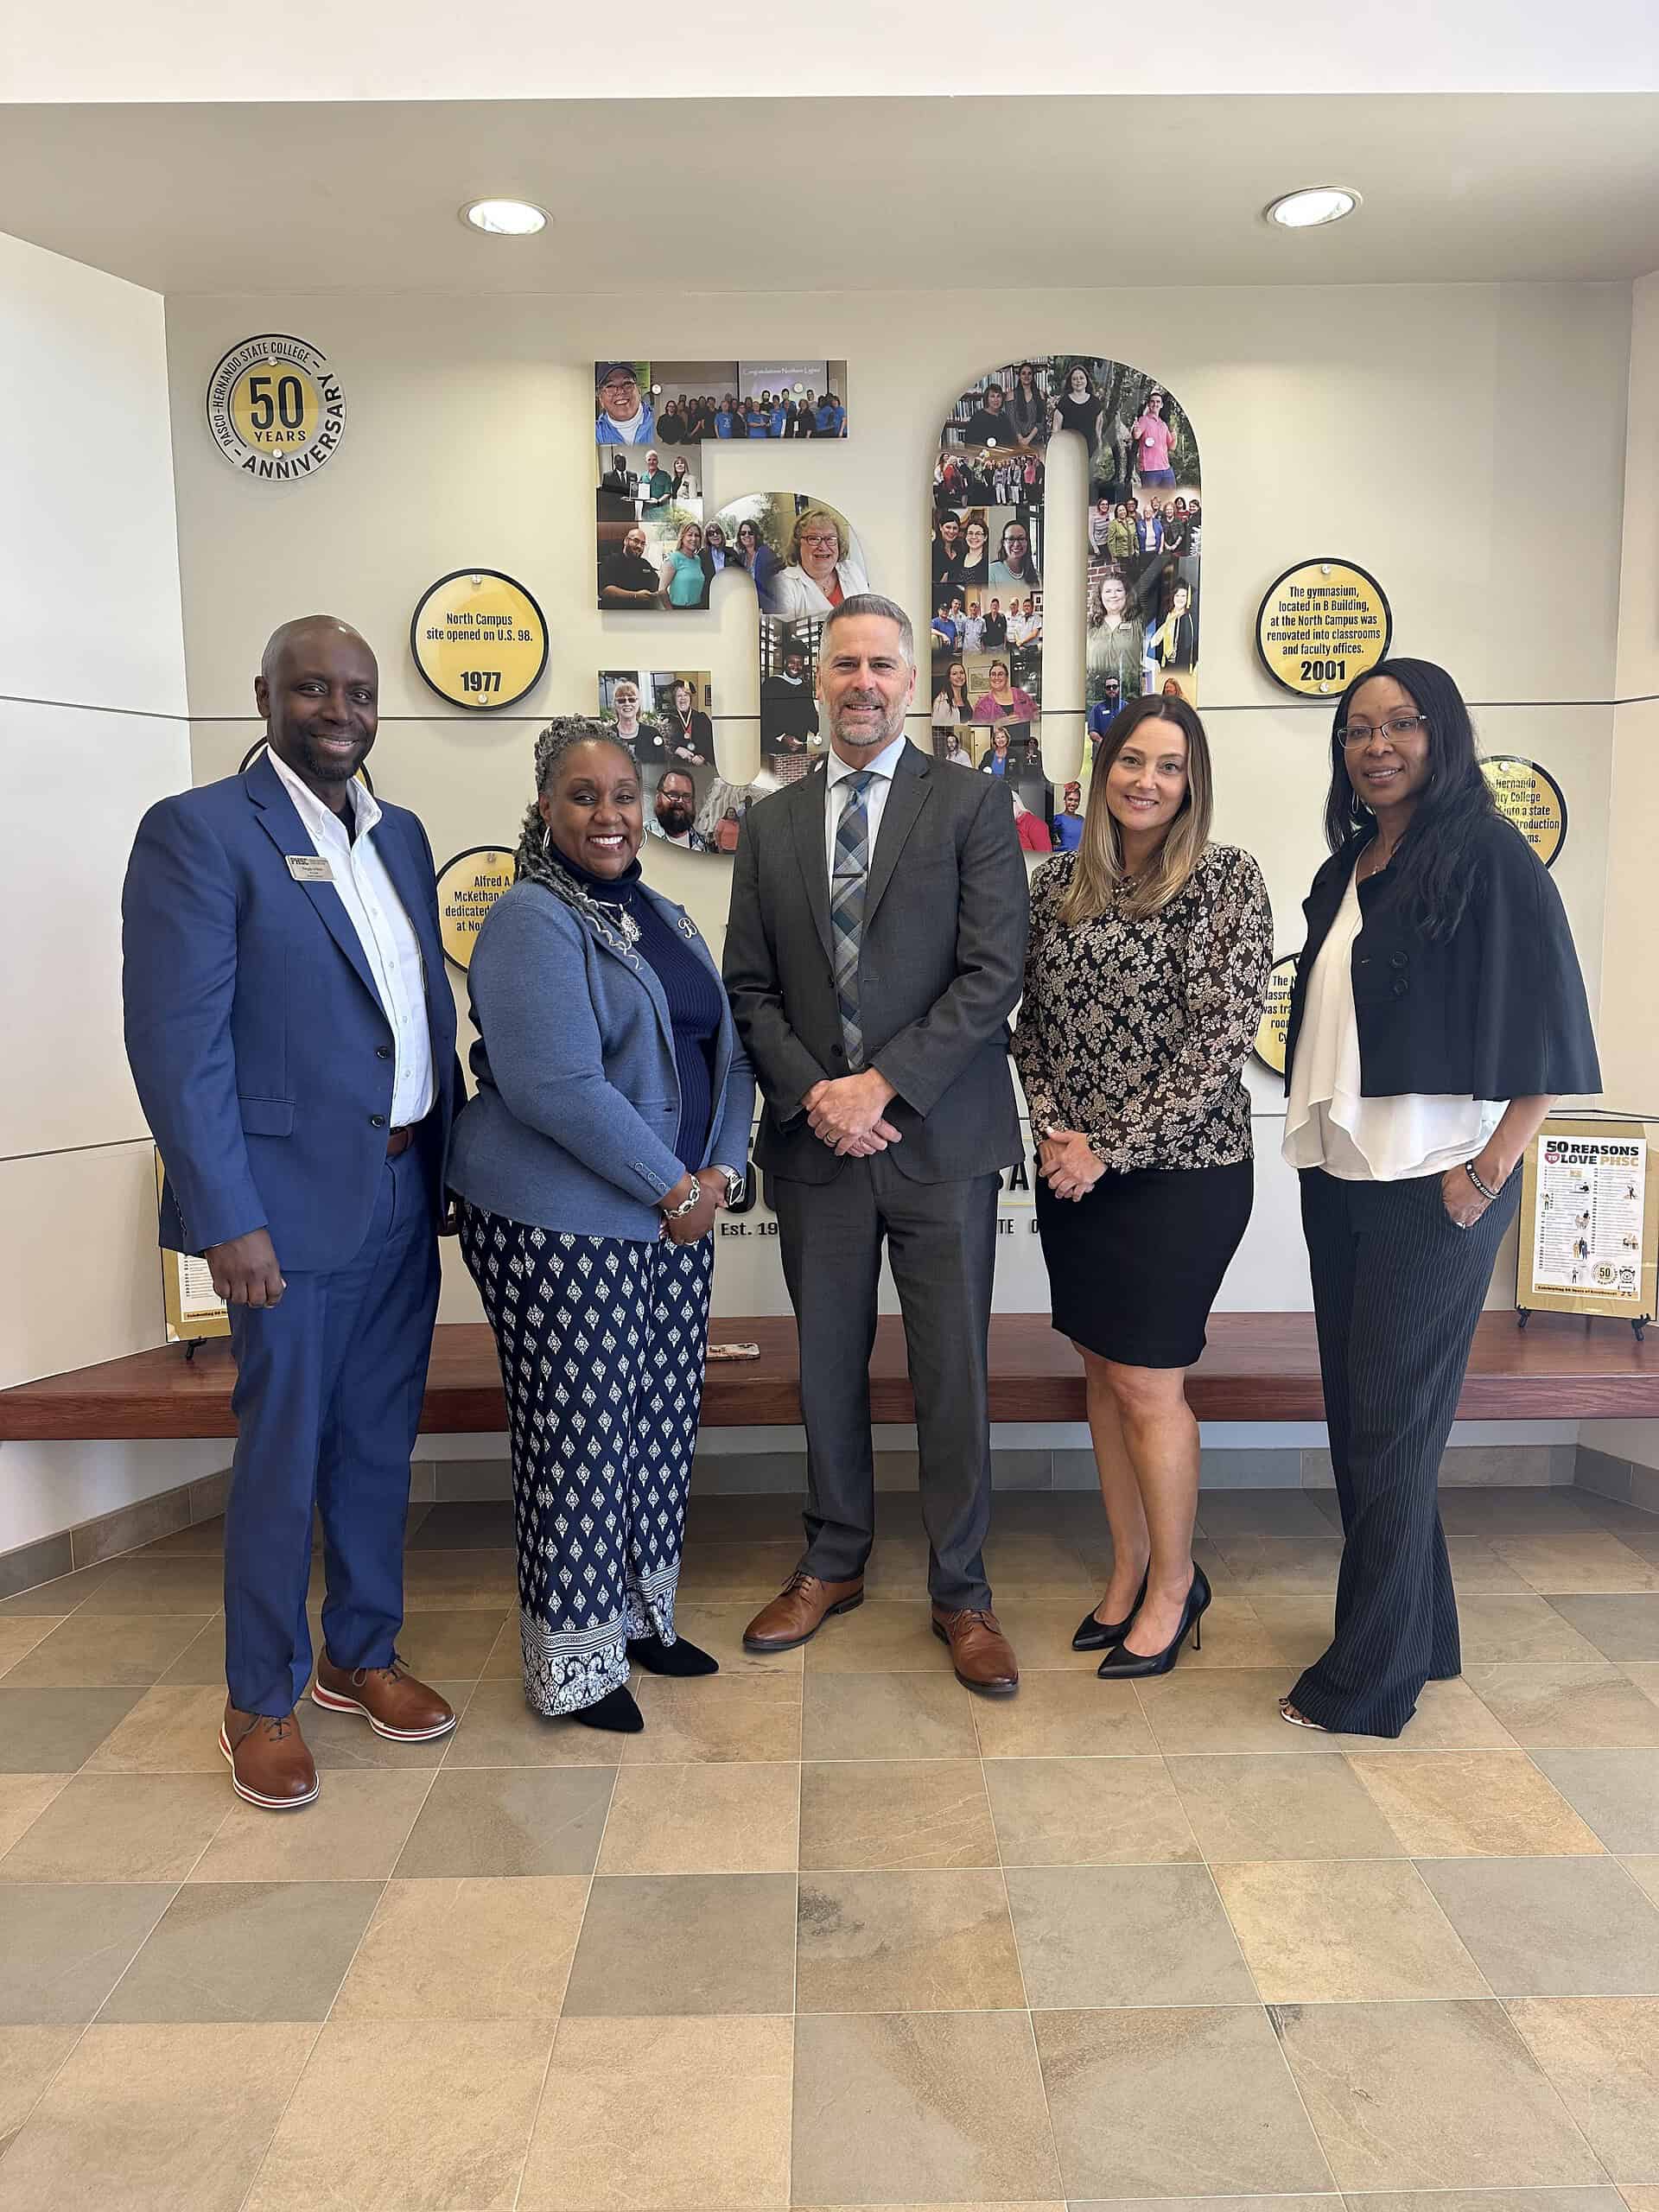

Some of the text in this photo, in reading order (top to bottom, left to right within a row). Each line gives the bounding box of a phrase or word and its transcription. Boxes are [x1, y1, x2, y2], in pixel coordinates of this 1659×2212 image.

[213, 341, 310, 447] PASCO-HERNANDO STATE COLLEGE
[250, 376, 303, 429] 50
[242, 373, 343, 479] ANNIVERSARY
[254, 430, 307, 442] YEARS
[1290, 585, 1359, 599] The gymnasium,
[1279, 599, 1370, 612] located in B Building,
[446, 613, 512, 627] North Campus
[1270, 614, 1377, 627] at the North Campus was
[427, 627, 532, 642] site opened on U.S. 98.
[1267, 628, 1381, 641] renovated into classrooms
[1282, 643, 1364, 656] and faculty offices.
[1300, 660, 1346, 681] 2001
[461, 671, 501, 692] 1977
[1511, 791, 1541, 804] College
[1522, 807, 1527, 816] a
[1529, 805, 1551, 816] state
[474, 874, 502, 887] Alfred
[454, 890, 499, 902] McKethan
[445, 905, 490, 917] dedicated
[456, 920, 467, 931] at
[1272, 976, 1288, 987] The
[1261, 1005, 1277, 1015] was
[1547, 1141, 1639, 1156] 50 REASONS
[1560, 1154, 1598, 1165] LOVE
[1599, 1155, 1639, 1166] PHSC
[720, 1223, 752, 1236] Est.
